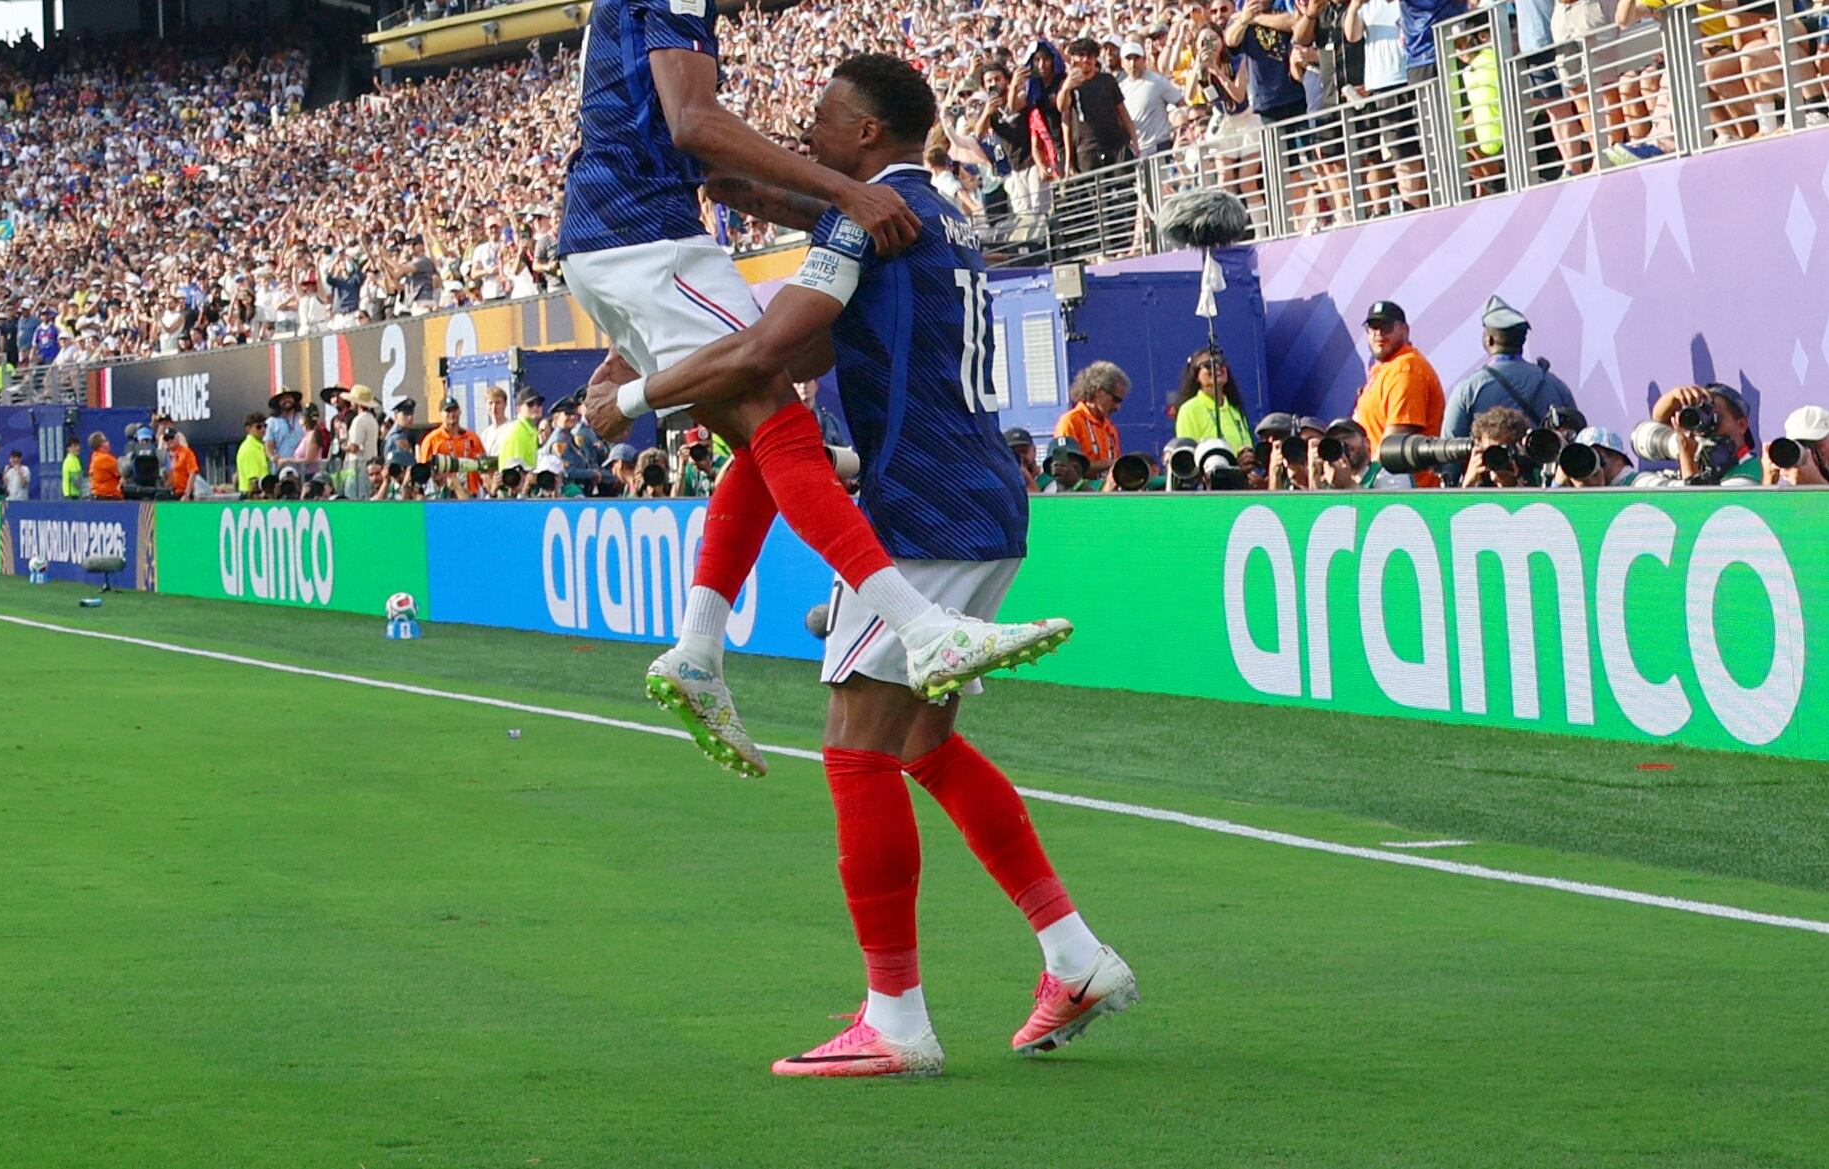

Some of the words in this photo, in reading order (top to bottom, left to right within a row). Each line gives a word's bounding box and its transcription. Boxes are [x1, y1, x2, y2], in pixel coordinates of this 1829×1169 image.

[156, 372, 211, 422] FRANCE
[379, 323, 408, 422] 2
[219, 507, 334, 605] aramco
[1223, 503, 1806, 746] aramco
